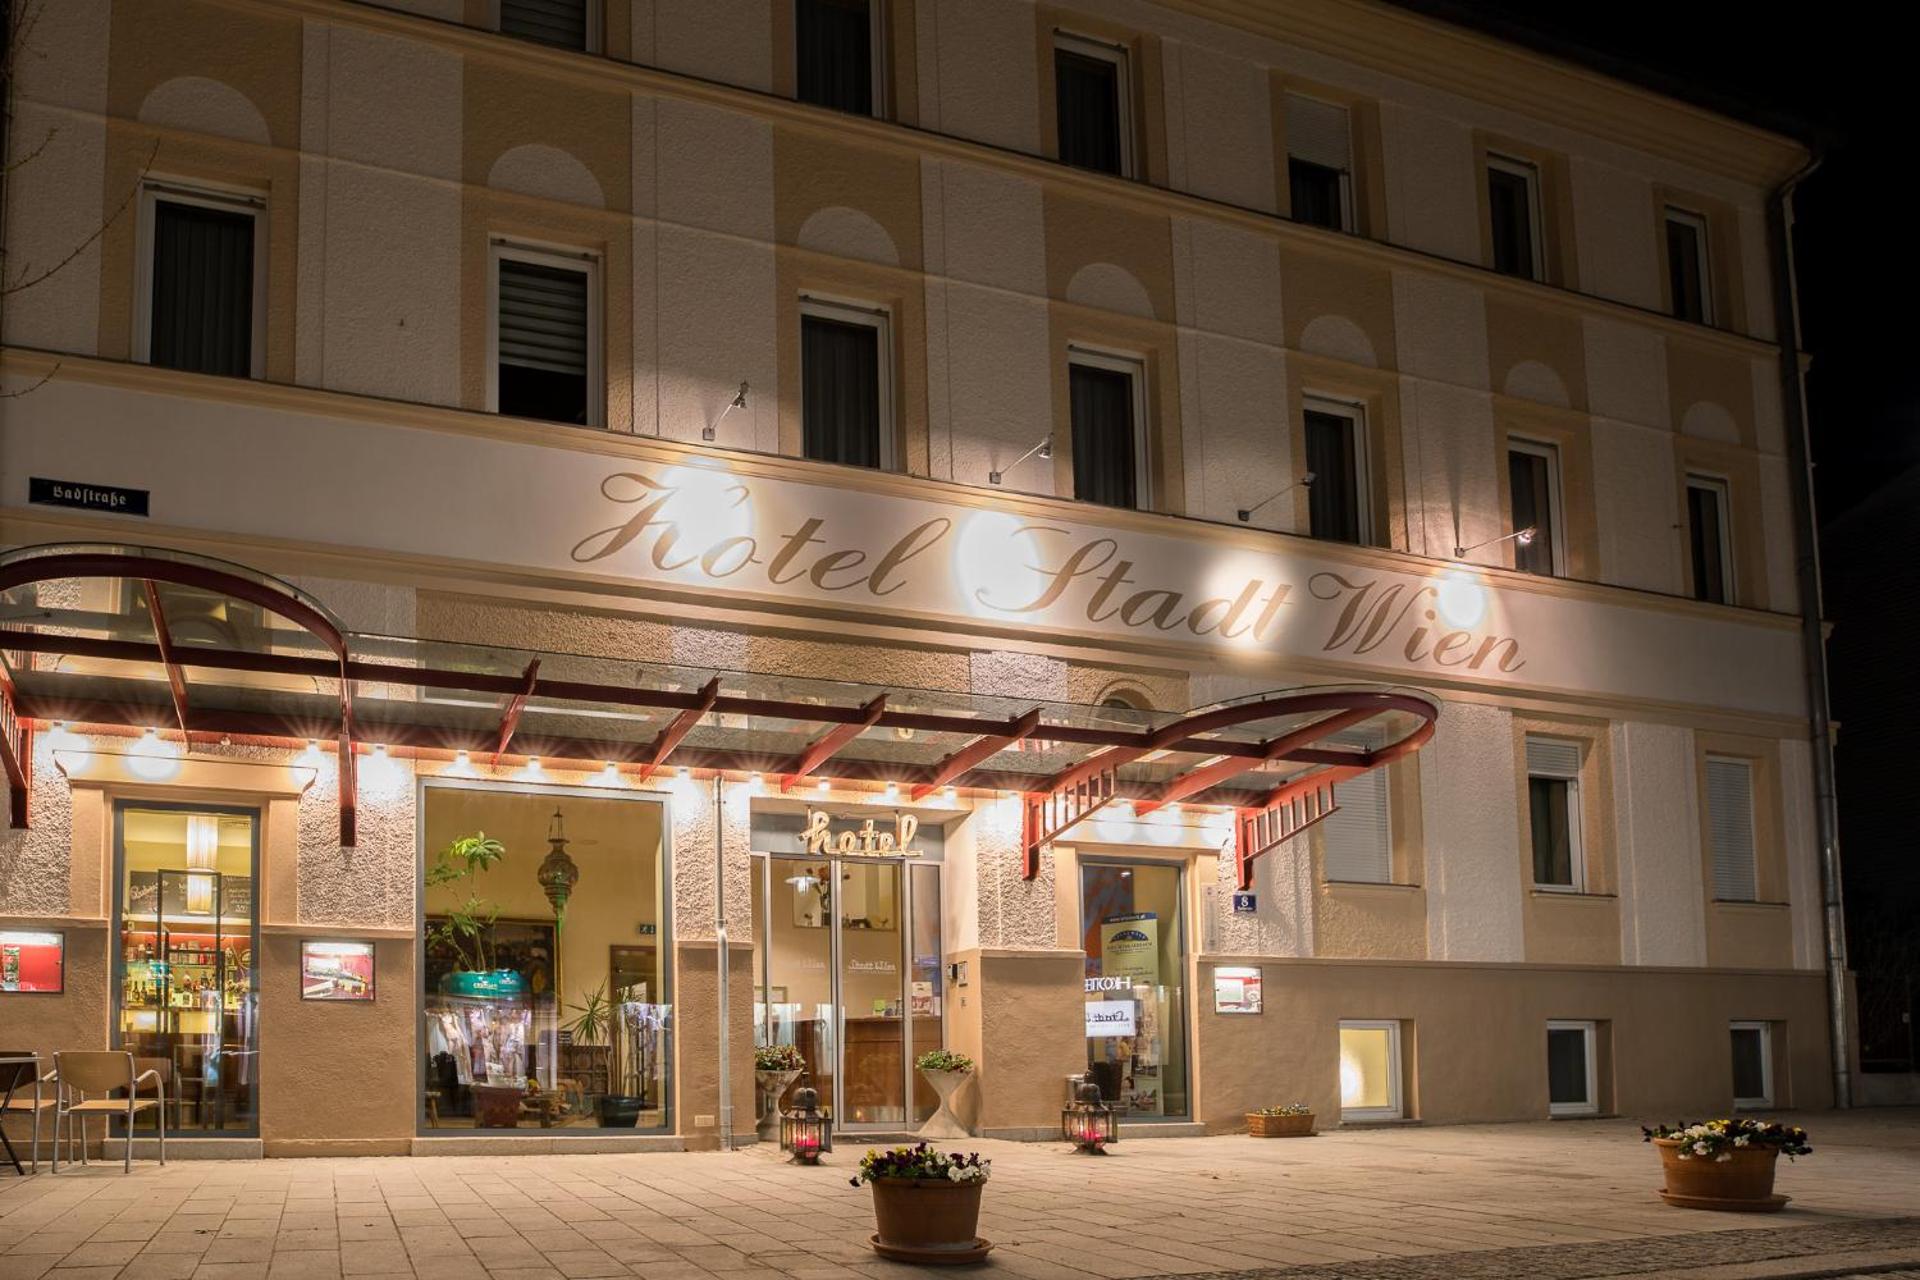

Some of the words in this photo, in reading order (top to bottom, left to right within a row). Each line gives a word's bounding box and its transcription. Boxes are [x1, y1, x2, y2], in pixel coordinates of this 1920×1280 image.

[571, 472, 951, 596] Hotel
[975, 526, 1293, 643] Stadt
[1308, 572, 1527, 673] Wien
[799, 811, 924, 857] hotel
[1241, 896, 1249, 907] 8
